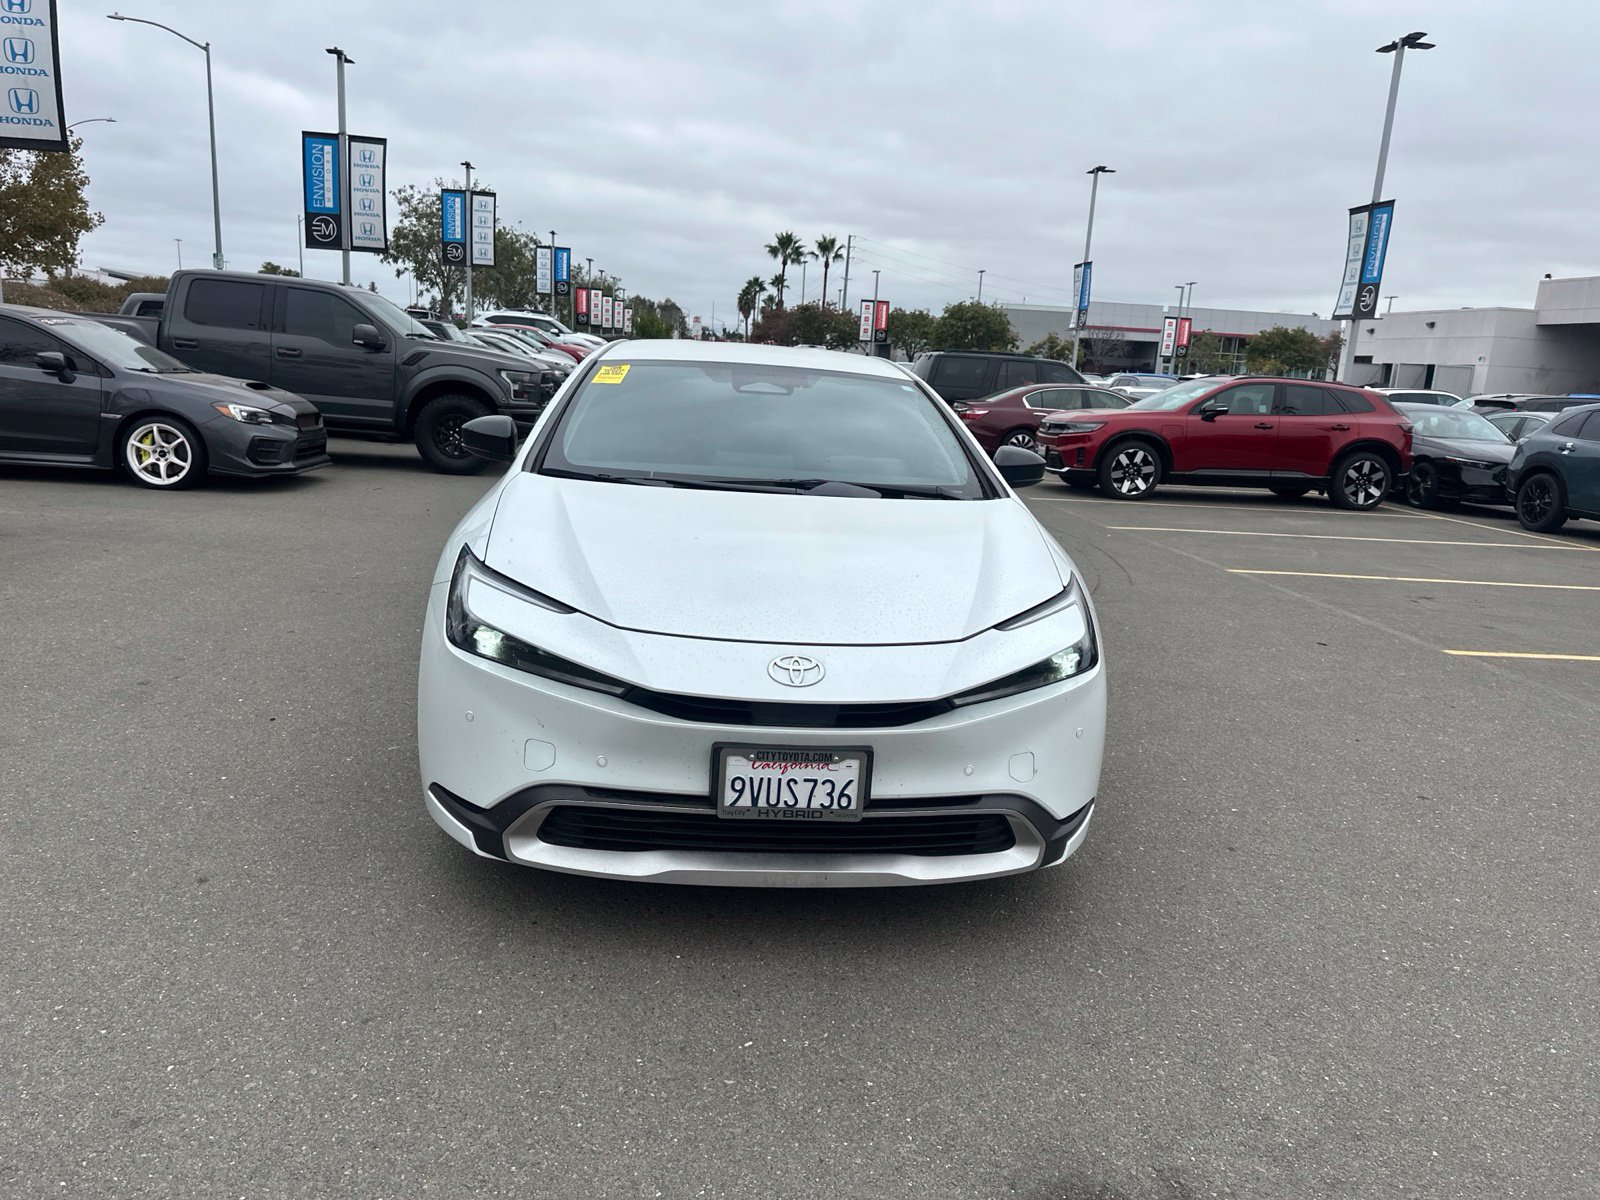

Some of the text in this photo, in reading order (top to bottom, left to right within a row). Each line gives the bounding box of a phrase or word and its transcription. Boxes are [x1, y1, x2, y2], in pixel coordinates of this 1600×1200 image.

[0, 15, 46, 27] ONDA
[0, 116, 54, 127] HONDA
[312, 144, 325, 208] ENVISION
[447, 196, 456, 239] ENVISION
[1366, 213, 1383, 278] ENVISION
[729, 776, 854, 809] 9VUS736
[758, 809, 823, 819] HYBRID
